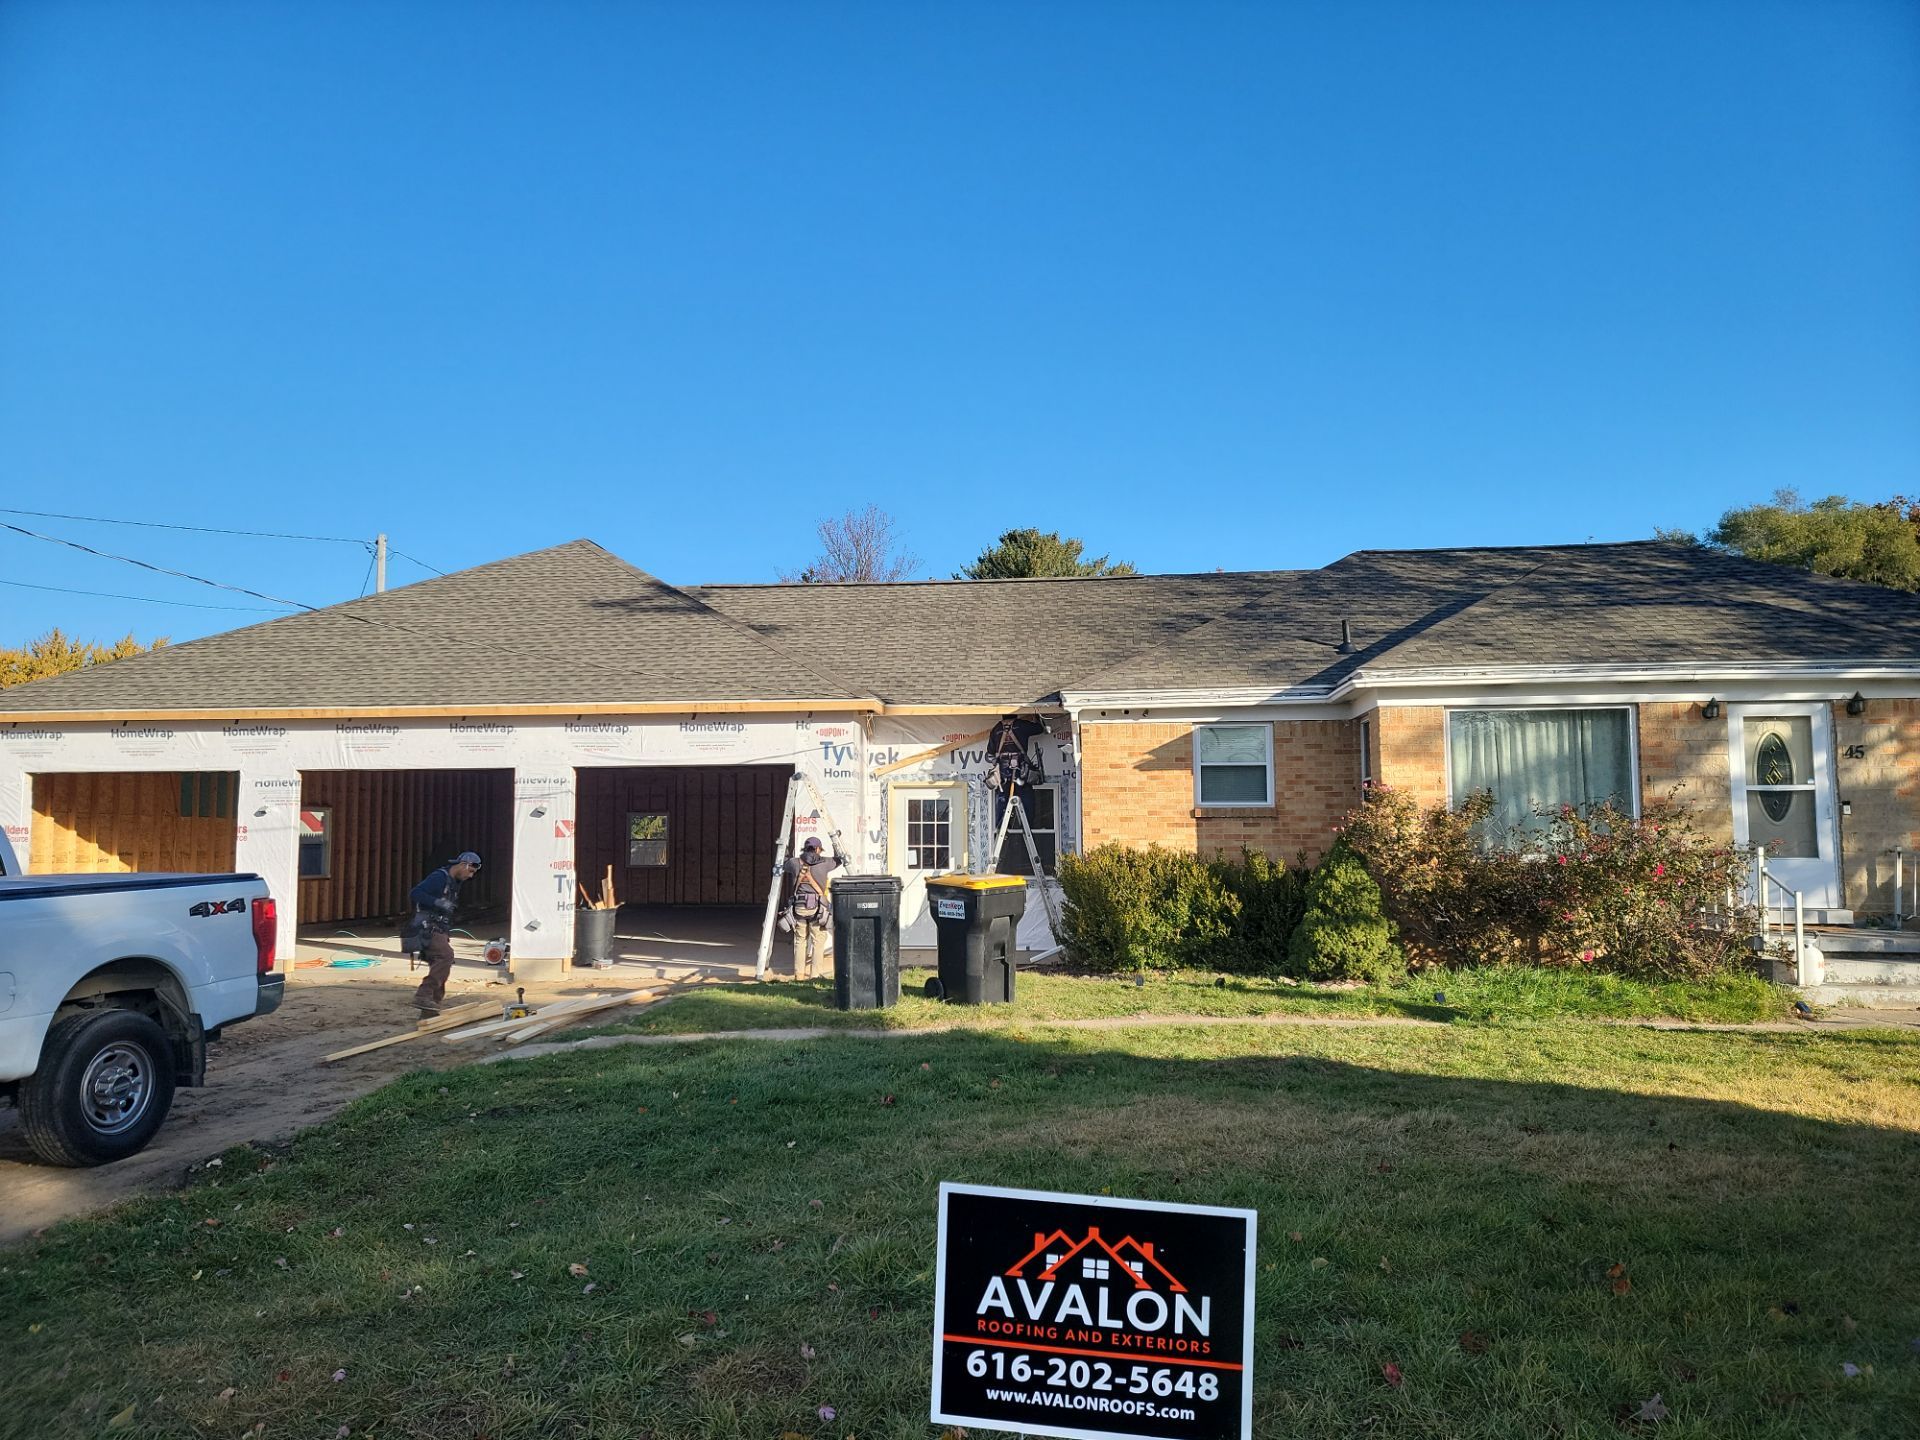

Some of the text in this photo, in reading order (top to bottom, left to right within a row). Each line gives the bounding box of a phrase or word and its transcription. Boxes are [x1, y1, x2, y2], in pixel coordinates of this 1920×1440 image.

[111, 728, 175, 739] HomeWrap
[223, 726, 287, 737] HomeWrap
[336, 724, 400, 735] HomeWrap
[450, 722, 515, 734] HomeWrap
[565, 722, 629, 735] HomeWrap
[679, 722, 745, 733] HomeWrap
[820, 728, 846, 737] DUPONT
[1, 729, 63, 741] HomeWrap
[976, 1276, 1211, 1336] AVALON
[977, 1319, 1211, 1353] ROOFING AND EXTERIORS
[966, 1350, 1219, 1401] 616-202-5648
[986, 1388, 1195, 1420] www.AVALONROOFS.com
